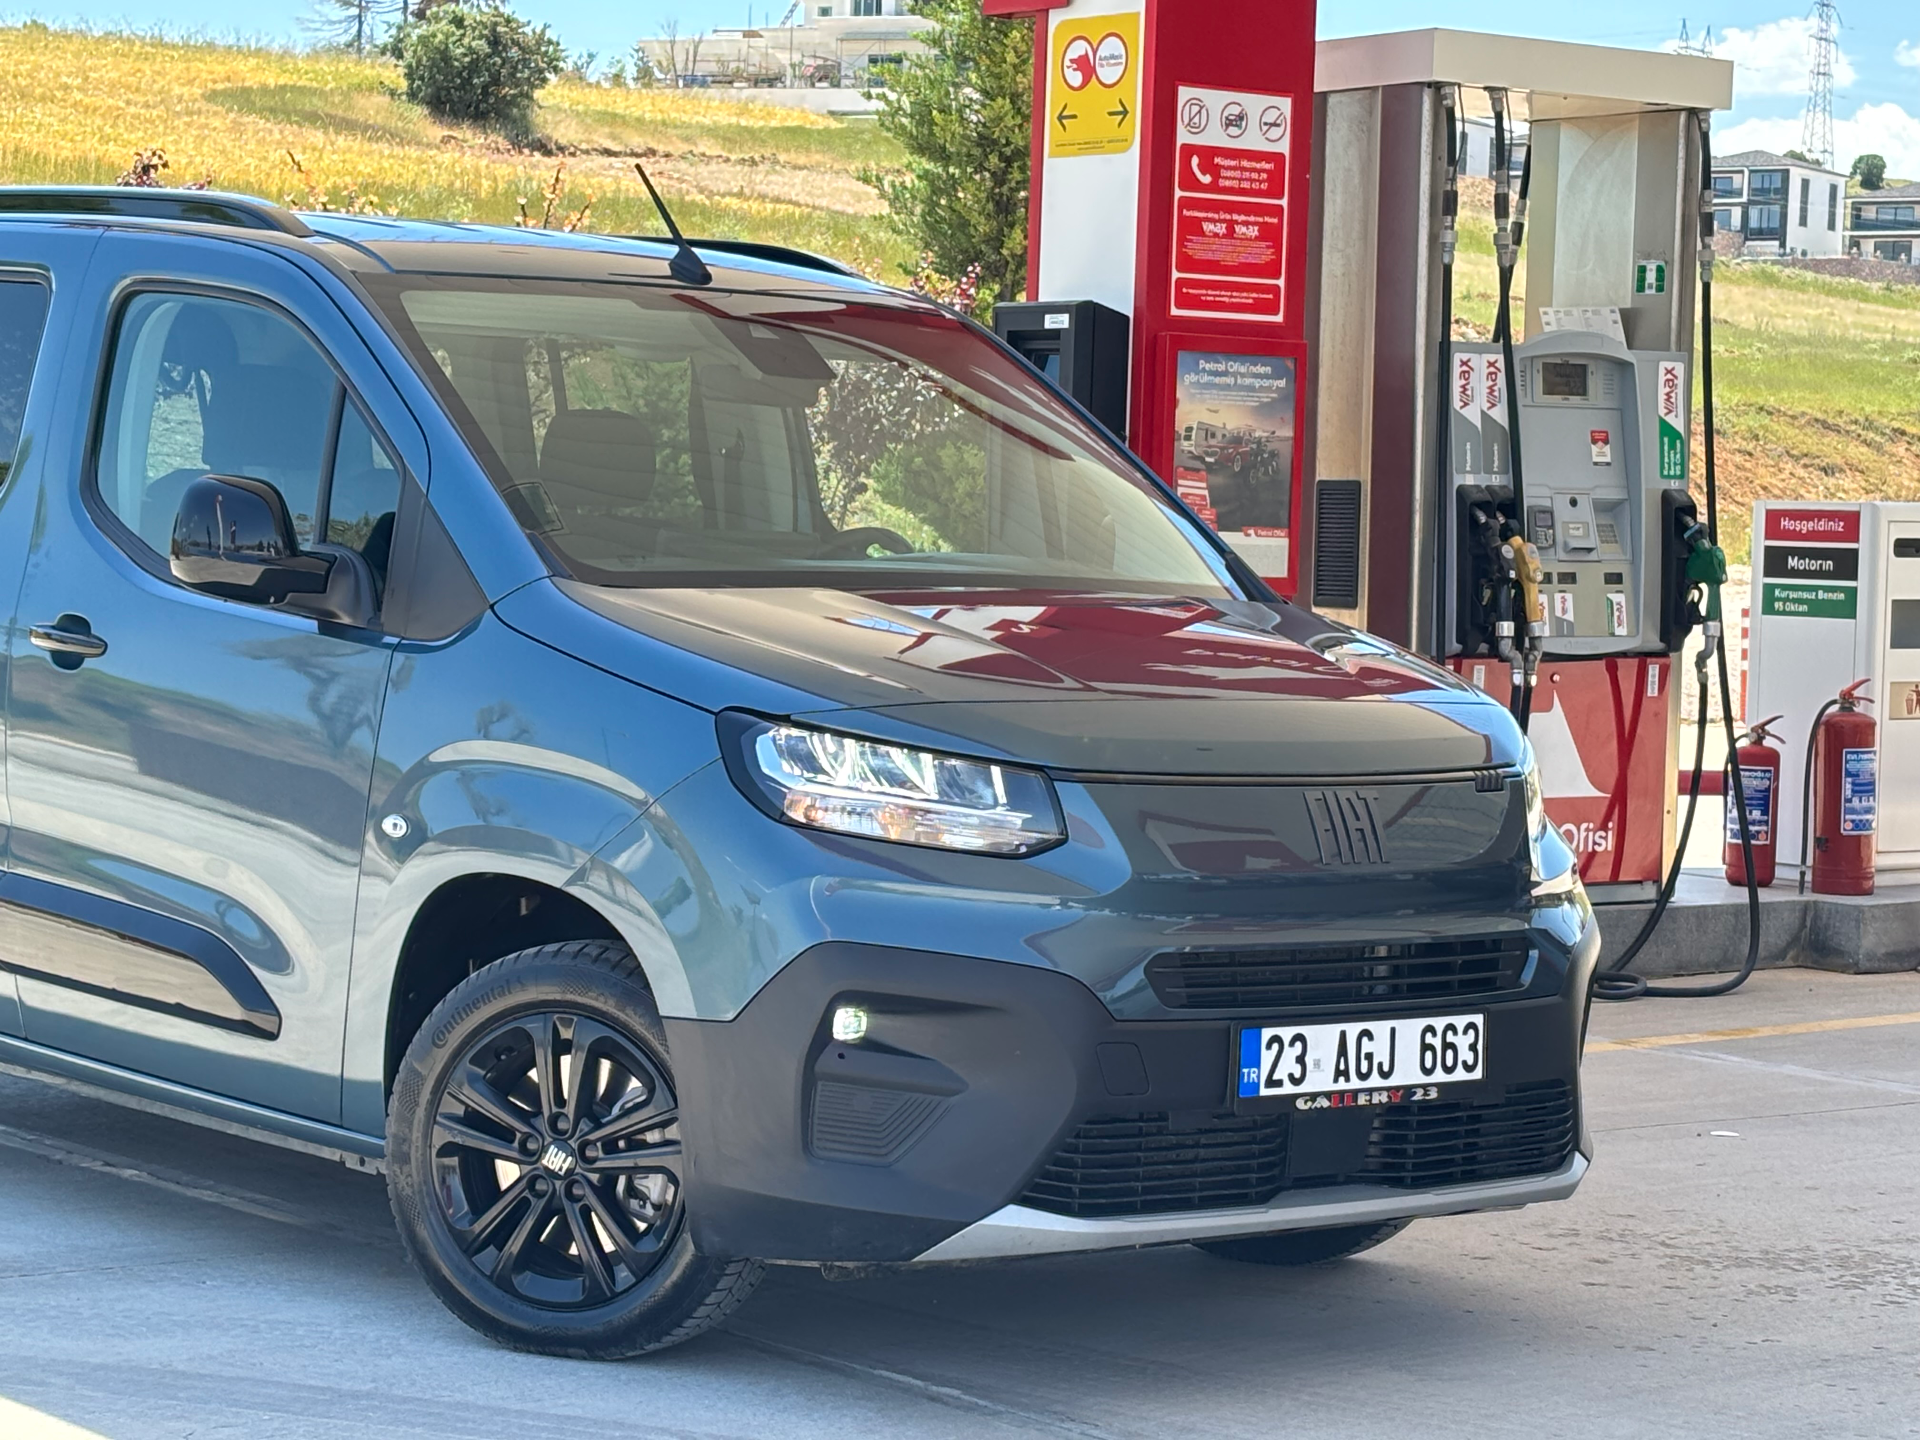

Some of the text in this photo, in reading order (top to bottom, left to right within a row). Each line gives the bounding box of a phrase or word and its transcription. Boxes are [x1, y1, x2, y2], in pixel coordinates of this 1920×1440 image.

[1199, 360, 1271, 374] Petrol Ofisi'nden
[1184, 372, 1286, 390] görülmemiş kampanya!
[1780, 517, 1844, 534] Hoşgeldiniz
[1774, 588, 1845, 600] Kurşunsuz Benzin
[1774, 602, 1808, 612] 95 Oktan
[1302, 790, 1390, 865] FIAT
[1558, 822, 1613, 852] Ofisi
[432, 979, 513, 1048] Continental
[1242, 1022, 1479, 1089] TR 23 AGJ 663
[1295, 1086, 1438, 1110] GALLERY 23
[542, 1144, 573, 1176] FIAT
